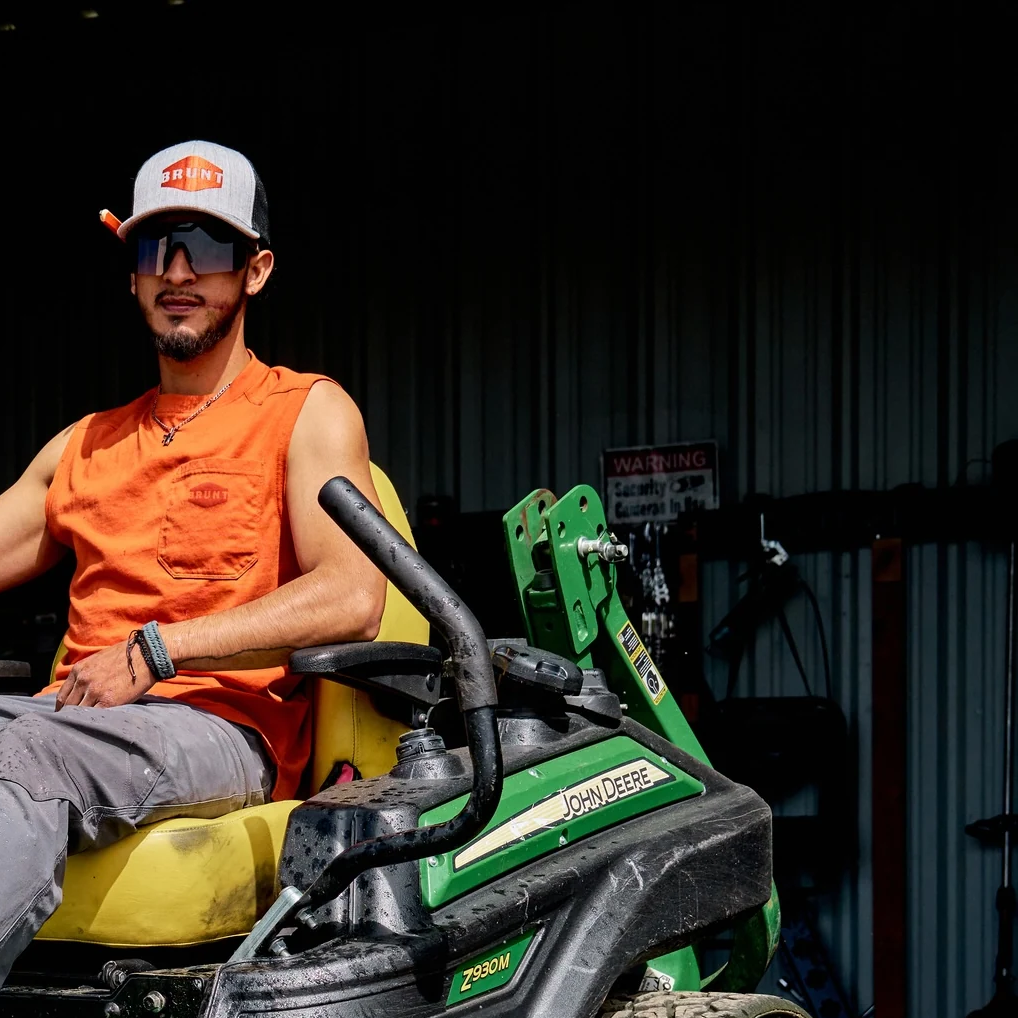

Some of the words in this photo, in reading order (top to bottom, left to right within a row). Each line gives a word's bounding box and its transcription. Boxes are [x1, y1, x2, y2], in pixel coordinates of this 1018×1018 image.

[162, 167, 223, 184] BRUNT
[614, 451, 706, 473] WARNING
[189, 490, 228, 500] BRUNT
[614, 479, 666, 497] Security
[614, 501, 666, 518] Cameras
[670, 498, 681, 514] In
[563, 785, 604, 818] JOHN
[601, 767, 651, 800] DEERE
[460, 952, 510, 992] Z930M
